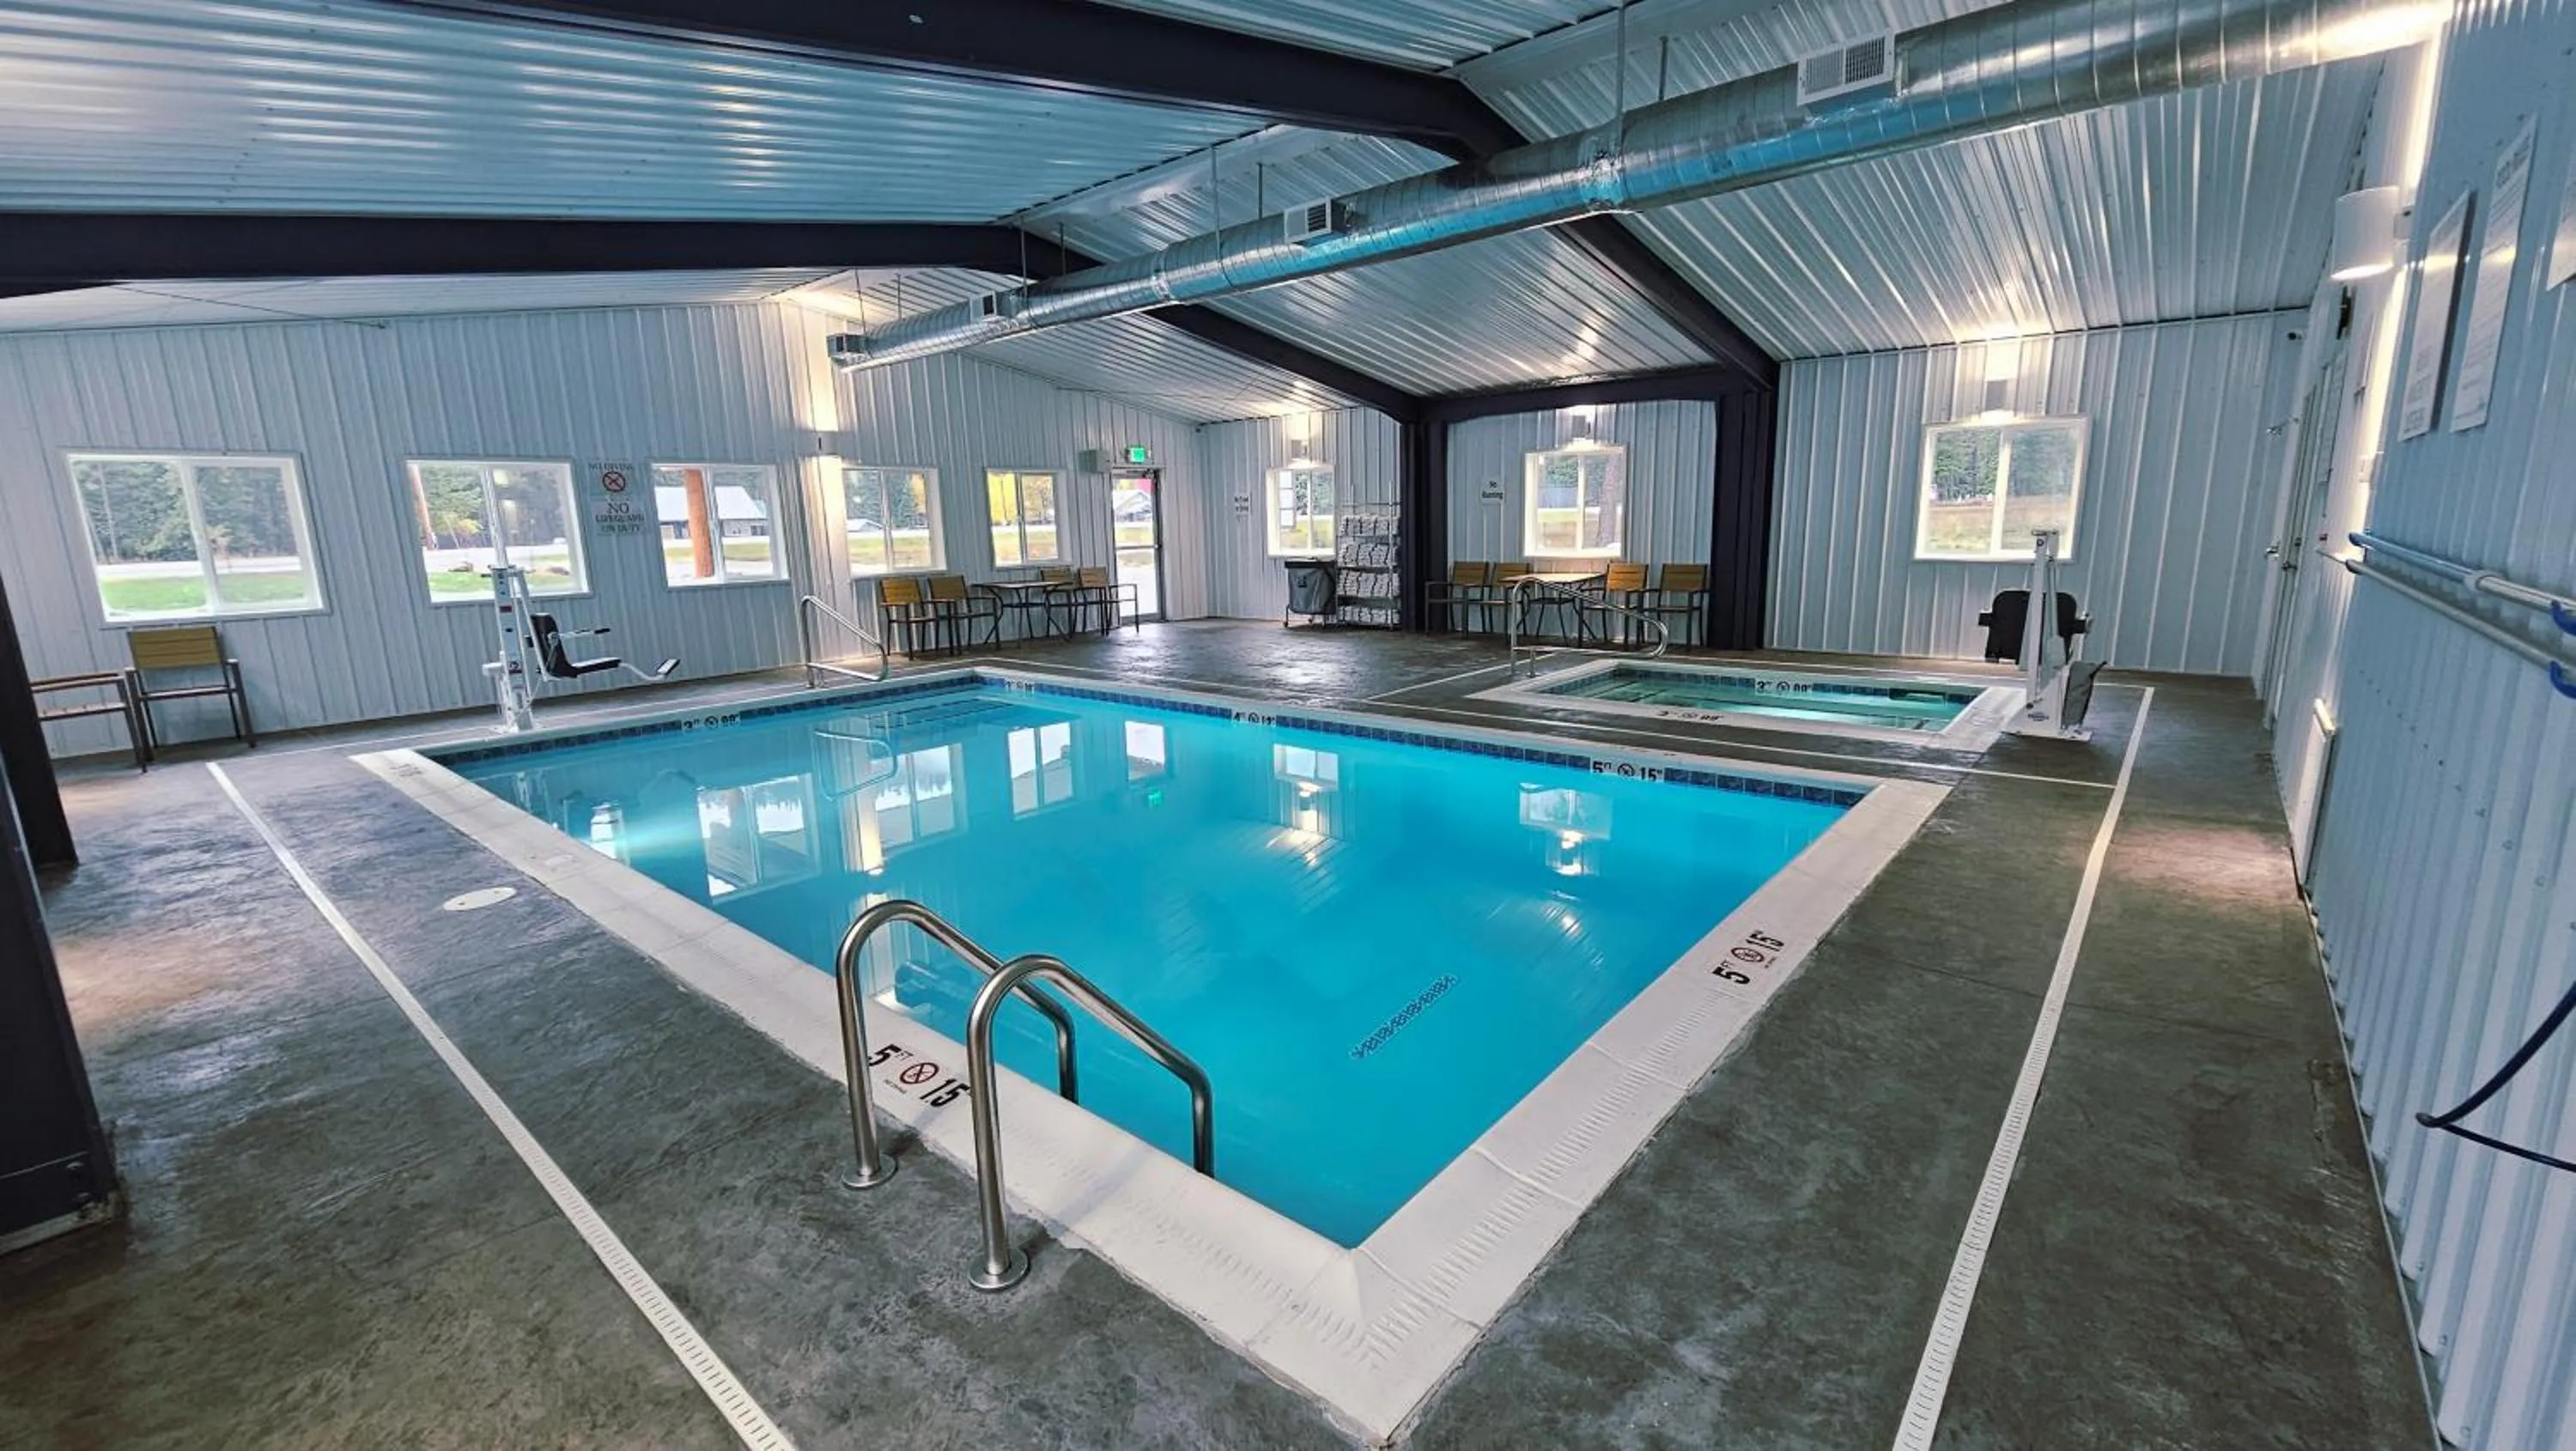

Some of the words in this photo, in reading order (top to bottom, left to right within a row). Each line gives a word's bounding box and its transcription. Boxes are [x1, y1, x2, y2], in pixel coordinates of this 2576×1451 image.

[607, 502, 629, 513] NO
[1711, 966, 1750, 985] 5
[867, 1043, 902, 1066] 5
